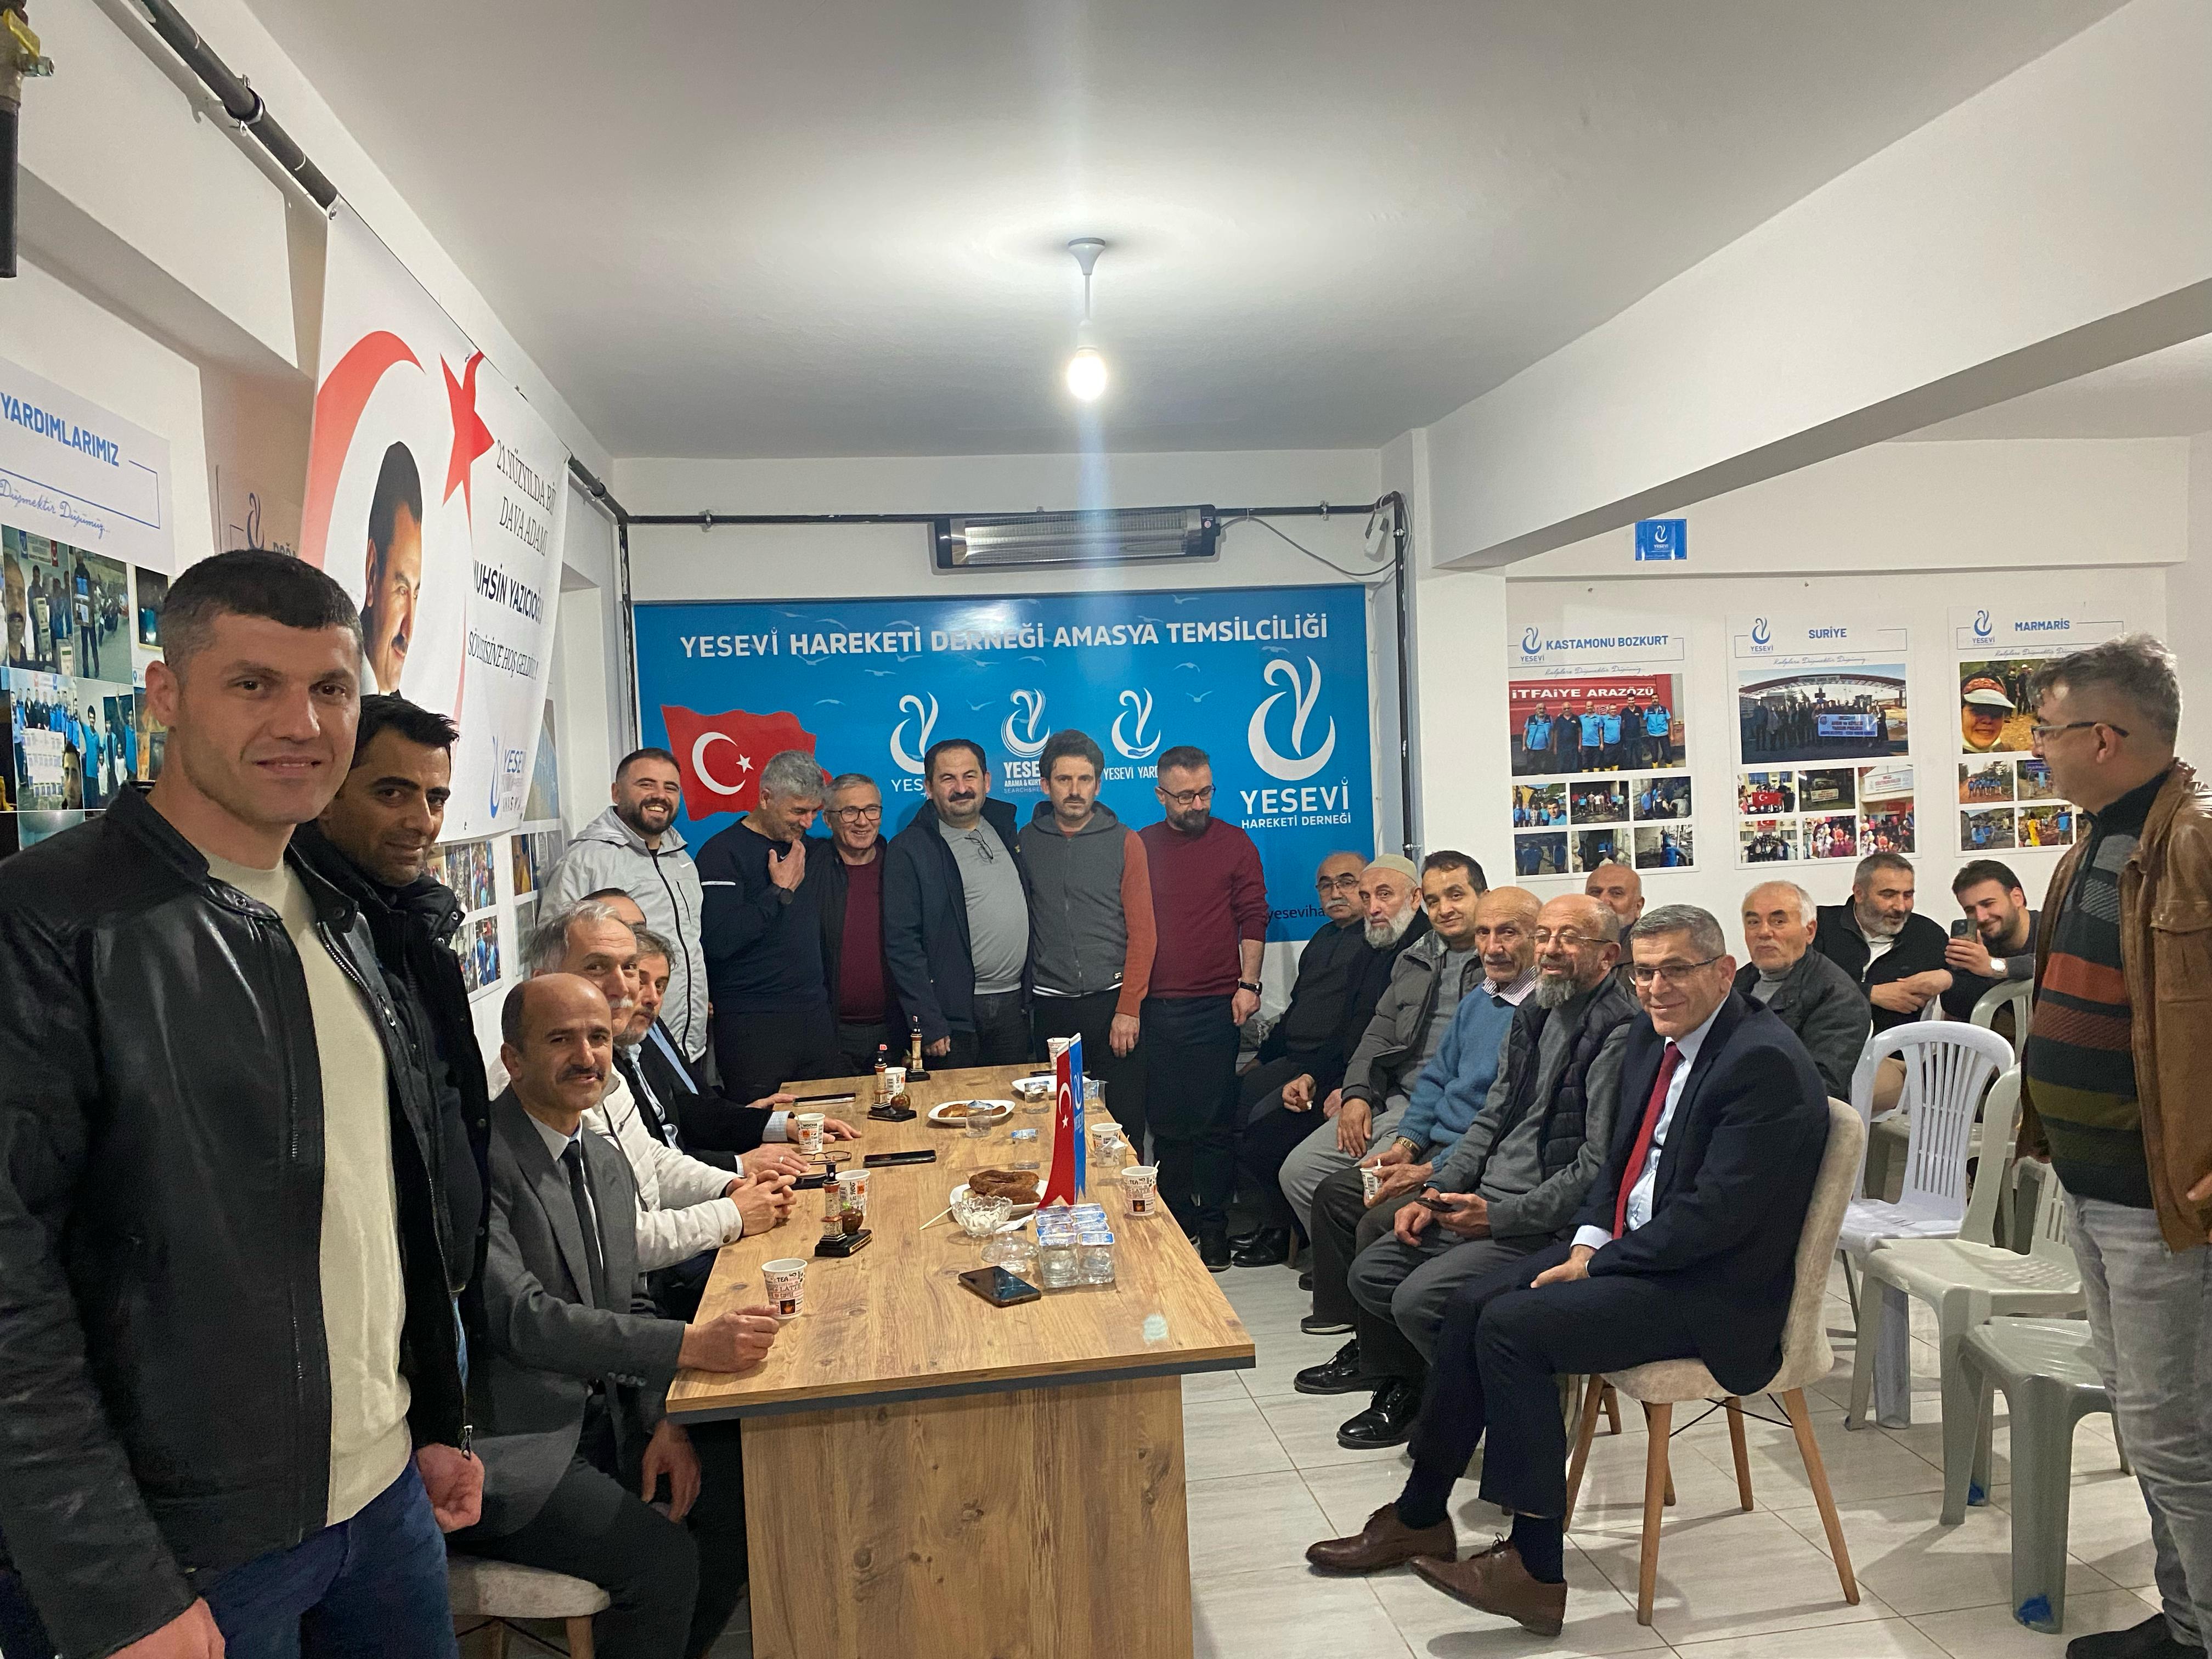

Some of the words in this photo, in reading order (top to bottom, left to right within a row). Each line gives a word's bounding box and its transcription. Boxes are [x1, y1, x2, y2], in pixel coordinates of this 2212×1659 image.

[1, 392, 119, 467] YARDIMLARIMIZ
[499, 496, 524, 540] DAVA
[1809, 626, 1847, 639] SURİYE
[2015, 618, 2070, 631] MARMARİS
[680, 627, 778, 658] YESEVİ
[791, 627, 922, 656] HAREKETİ
[931, 622, 1043, 652] DERNEĞİ
[1053, 624, 1159, 647] AMASYA
[1166, 613, 1328, 644] TEMSİLCİLİĞİ
[1546, 637, 1615, 650] KASTAMONU
[1618, 635, 1669, 647] BOZKURT
[1003, 760, 1041, 778] YESE
[1103, 765, 1134, 780] YESEVİ
[891, 778, 924, 792] YES
[1240, 776, 1348, 815] YESEVİ
[1242, 815, 1297, 829] HAREKETİ
[1302, 812, 1351, 826] DERNEĞİ
